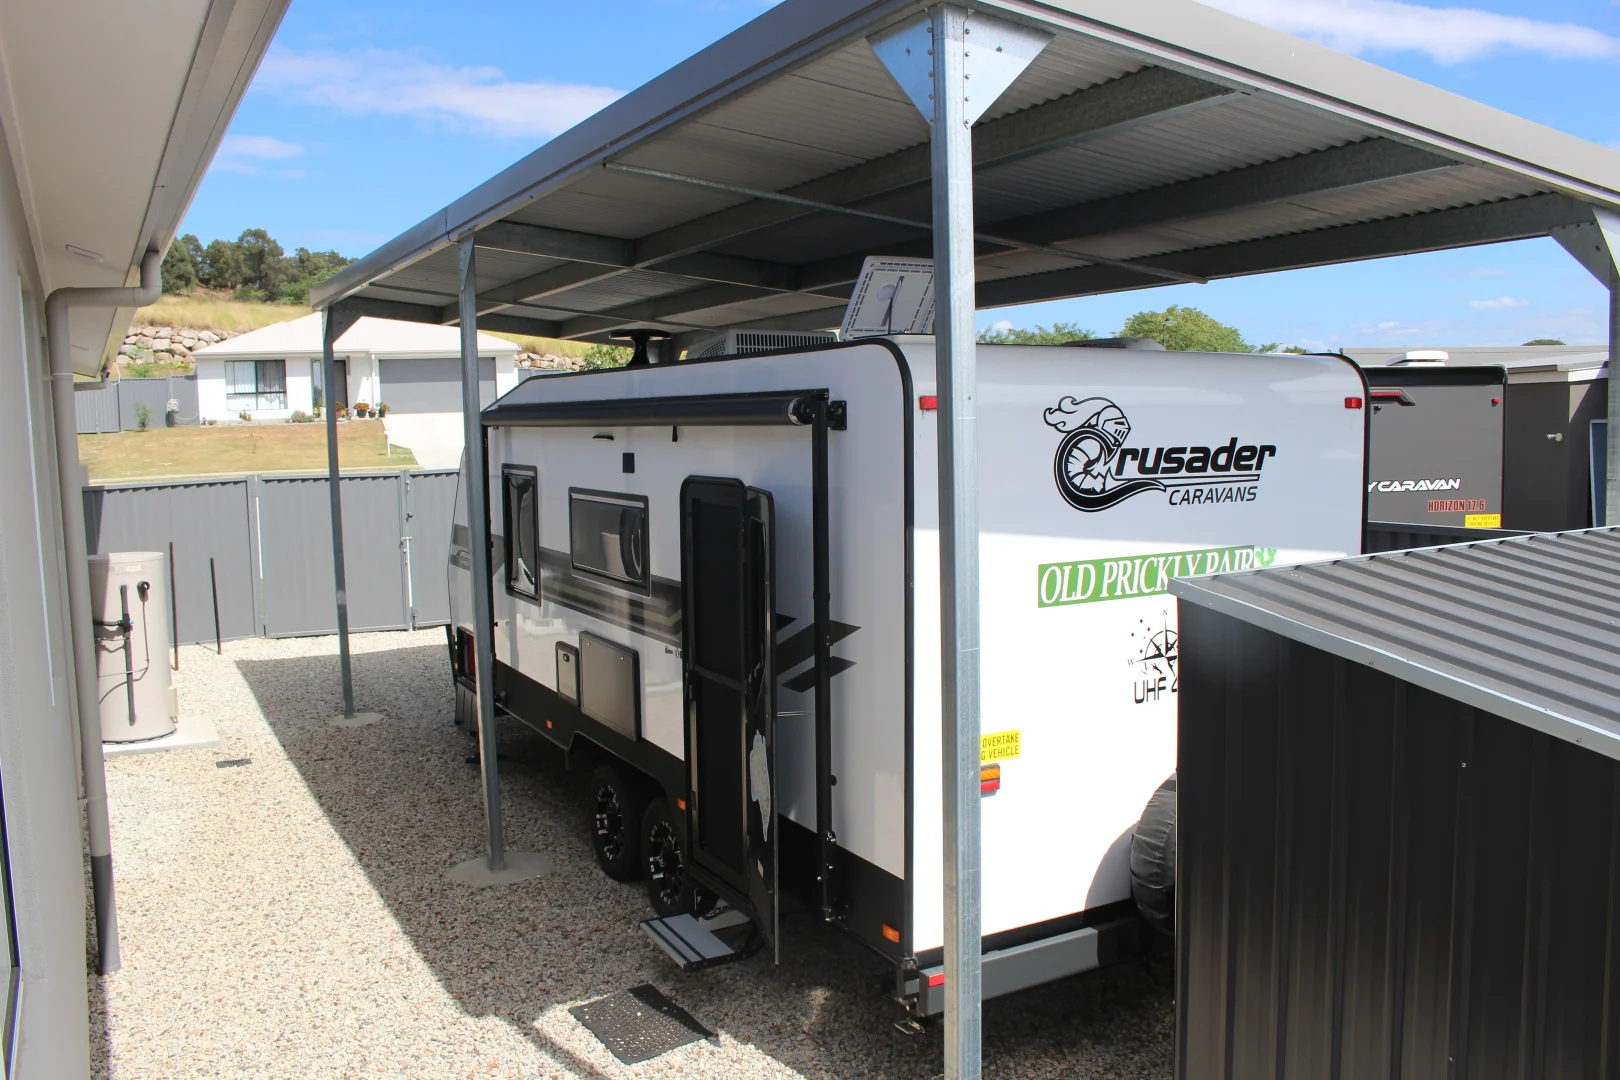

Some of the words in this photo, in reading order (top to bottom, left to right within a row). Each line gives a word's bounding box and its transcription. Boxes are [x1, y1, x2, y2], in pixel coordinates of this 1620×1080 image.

[1168, 485, 1258, 506] CARAVANS
[1428, 500, 1466, 512] HORIZON
[1467, 499, 1485, 511] 17.6
[1040, 563, 1096, 604] OLD
[1133, 676, 1167, 704] UHF
[982, 732, 1019, 748] OVERTAKE
[988, 745, 1019, 759] VEHICLE
